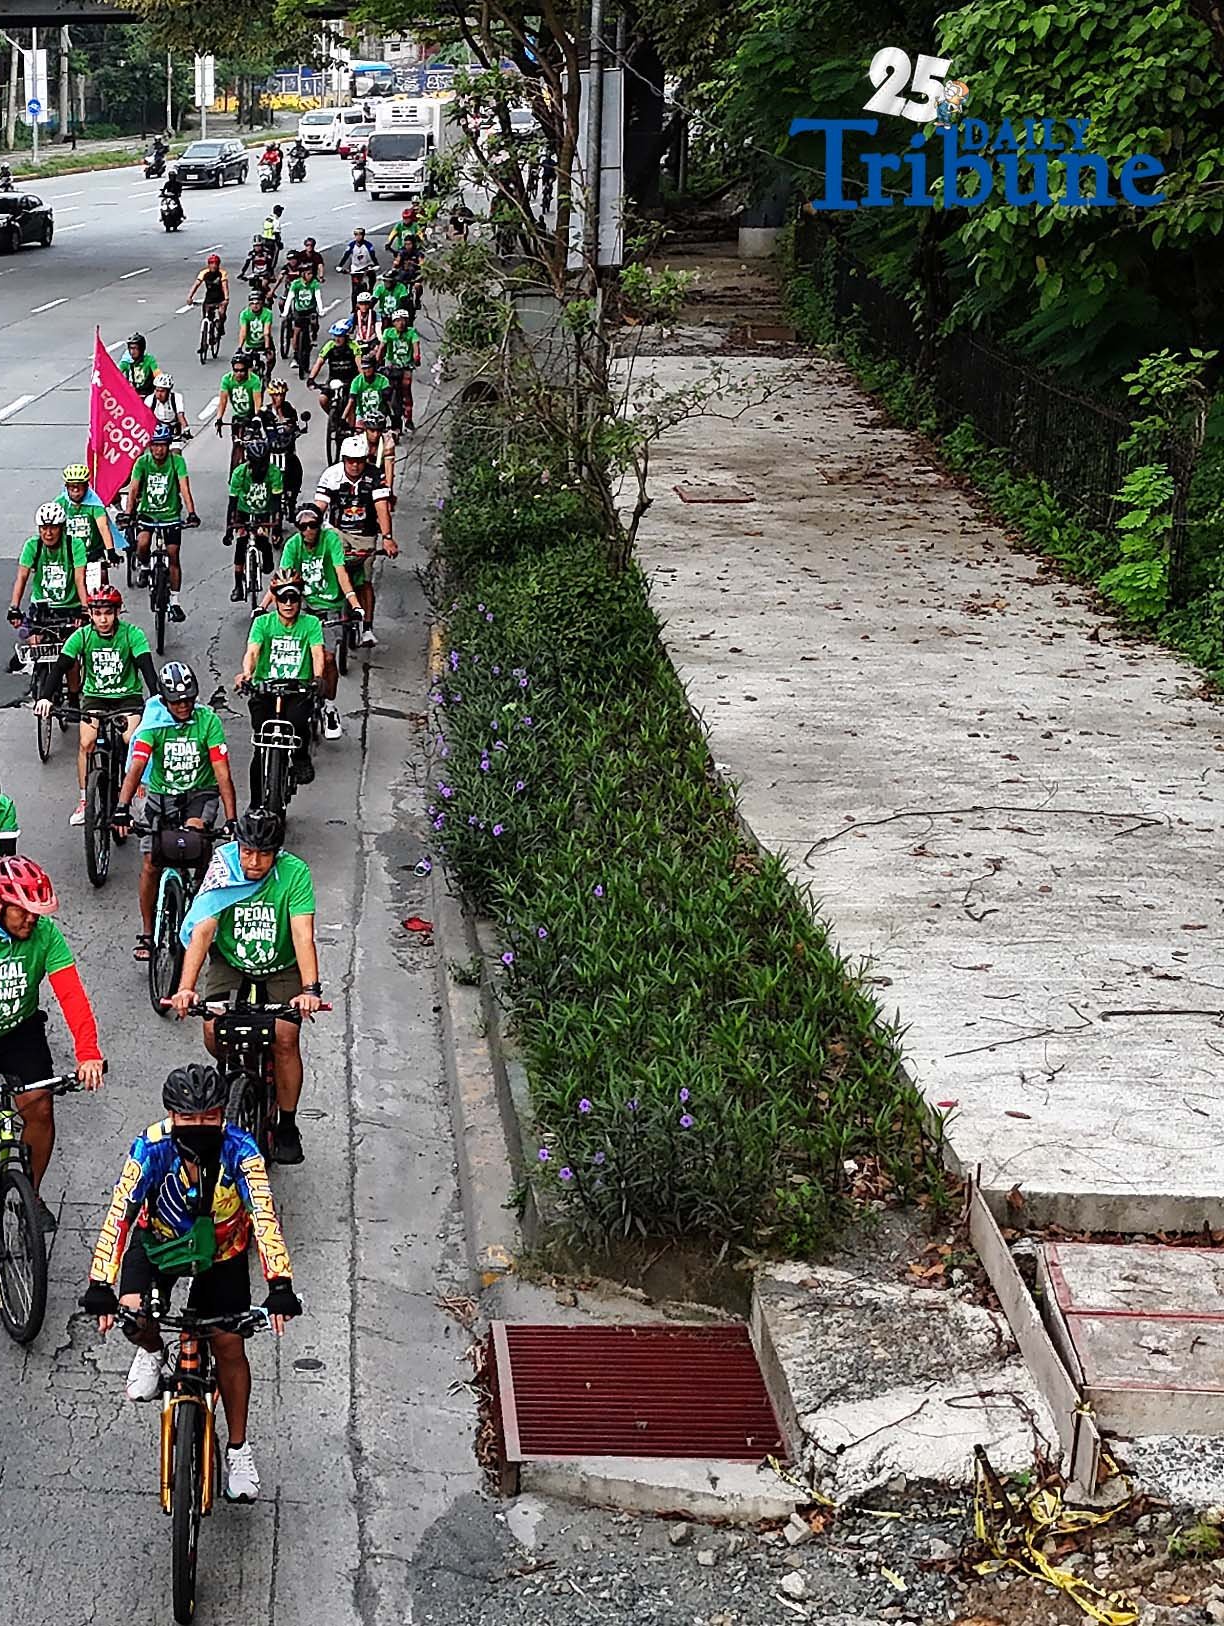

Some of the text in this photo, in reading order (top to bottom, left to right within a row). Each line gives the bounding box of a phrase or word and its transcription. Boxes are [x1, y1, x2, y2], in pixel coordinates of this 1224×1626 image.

[121, 416, 151, 447] OUR
[164, 742, 200, 756] PEDAL
[234, 907, 277, 922] PEDAL
[234, 927, 277, 943] PLANET
